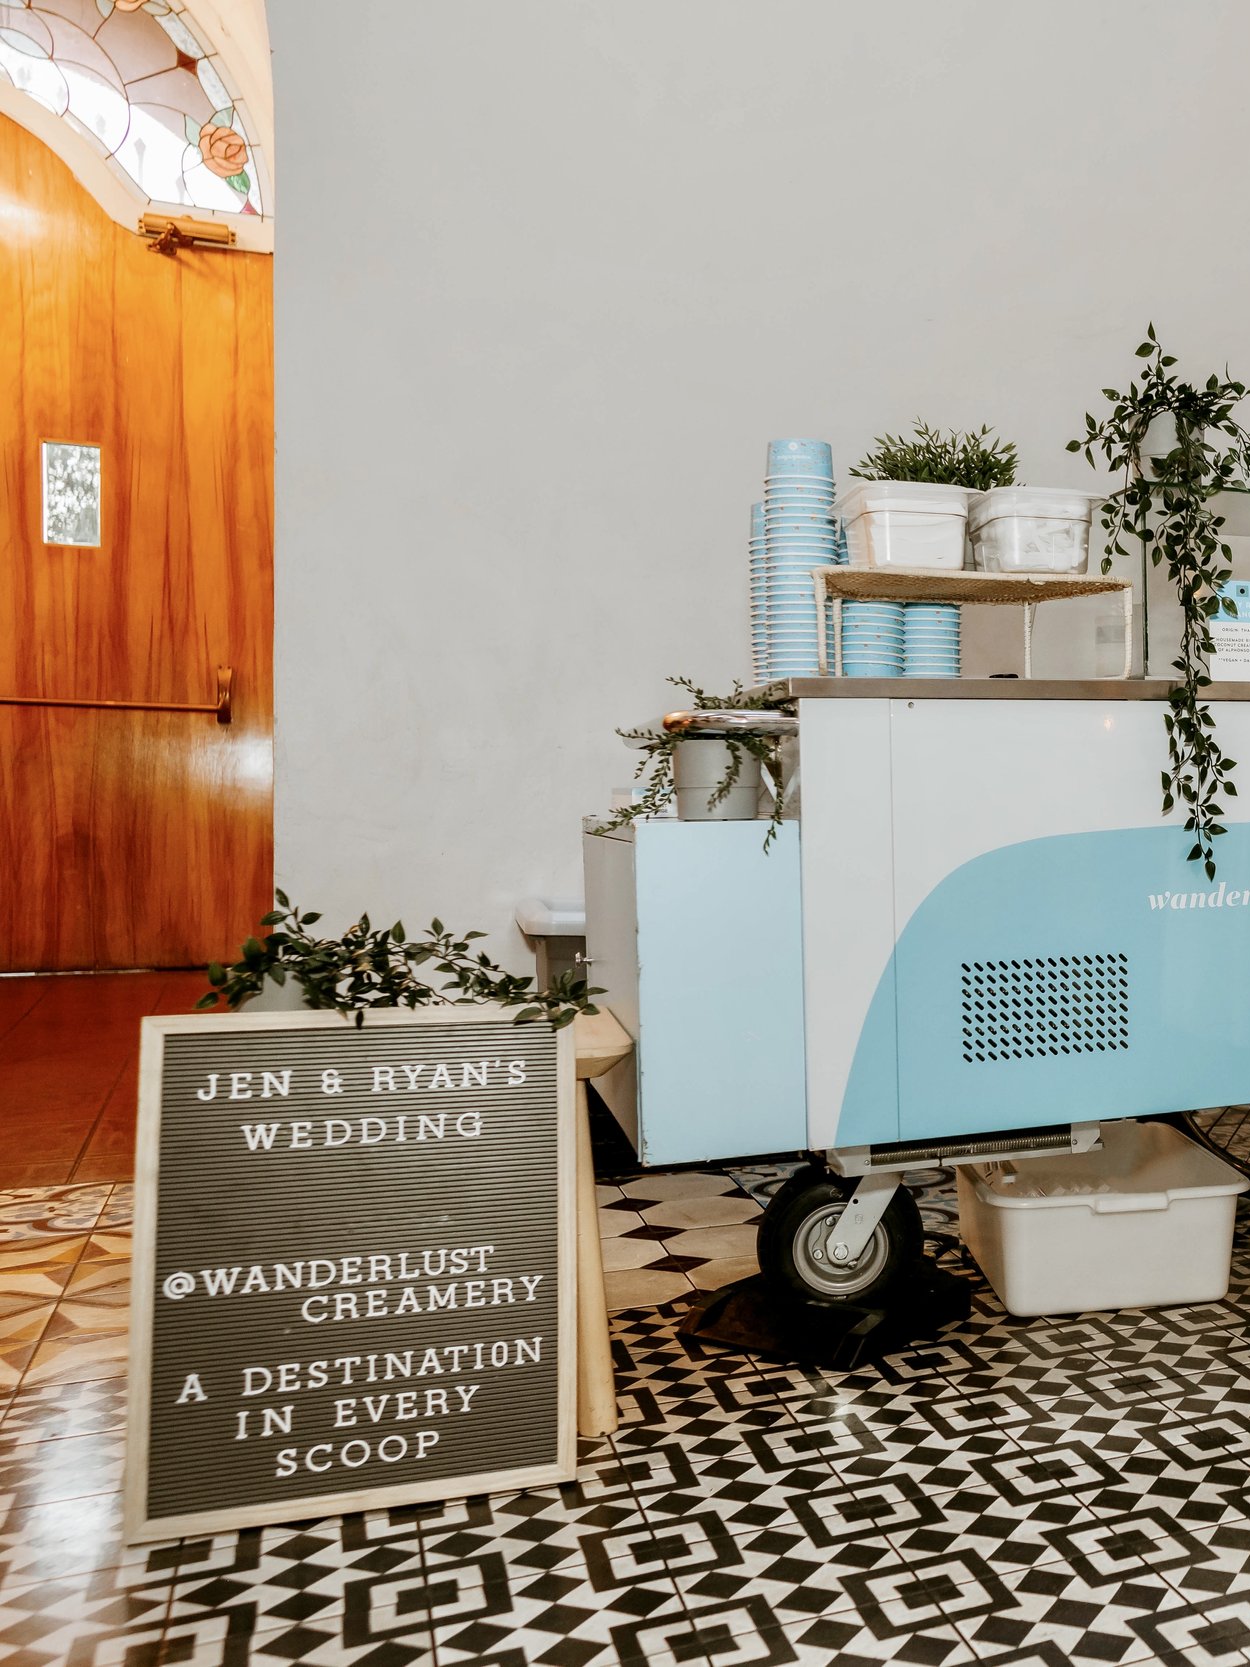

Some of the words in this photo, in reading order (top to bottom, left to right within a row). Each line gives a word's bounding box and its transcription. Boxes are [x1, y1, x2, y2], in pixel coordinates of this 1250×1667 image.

[196, 1070, 293, 1102] JEN
[321, 1067, 344, 1095] &
[370, 1059, 528, 1093] RYAN'S
[239, 1111, 485, 1152] WEDDING
[162, 1245, 495, 1301] @WANDERLUST
[300, 1275, 545, 1324] CREAMERY
[174, 1373, 210, 1404] A
[240, 1336, 544, 1397] DESTINATION
[234, 1405, 296, 1440] IN
[333, 1384, 482, 1428] EVERY
[275, 1430, 441, 1477] SCOOP
